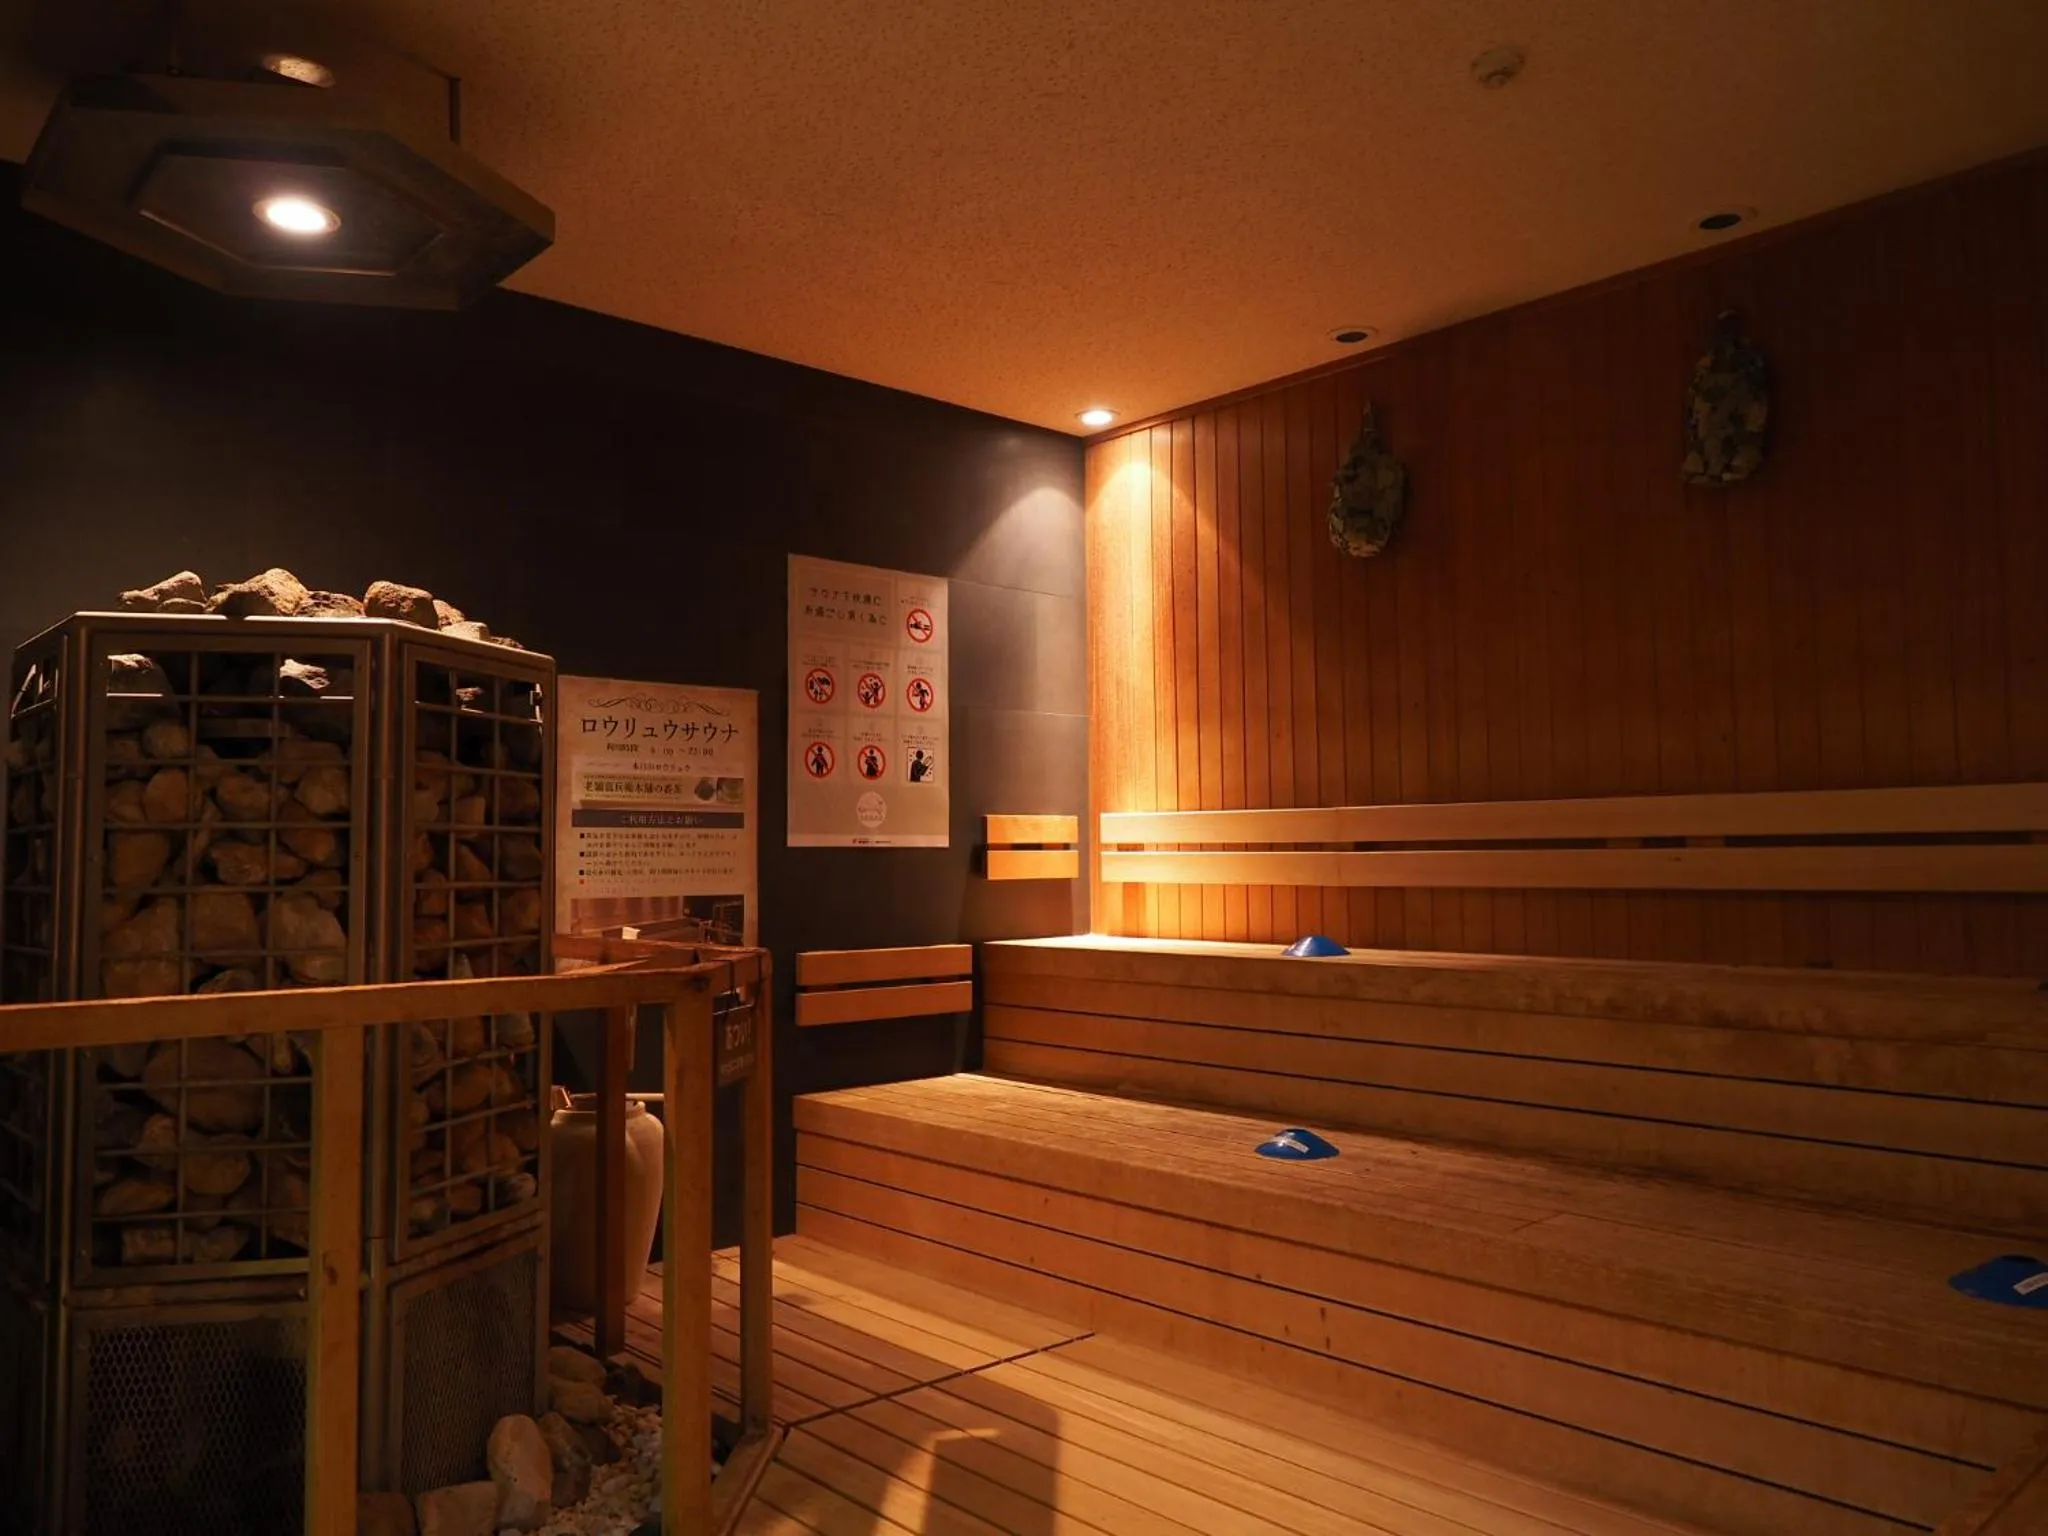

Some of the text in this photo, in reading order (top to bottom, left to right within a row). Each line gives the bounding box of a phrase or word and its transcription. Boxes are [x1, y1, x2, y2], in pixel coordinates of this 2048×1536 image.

[581, 715, 739, 744] ロウリュウサウナ
